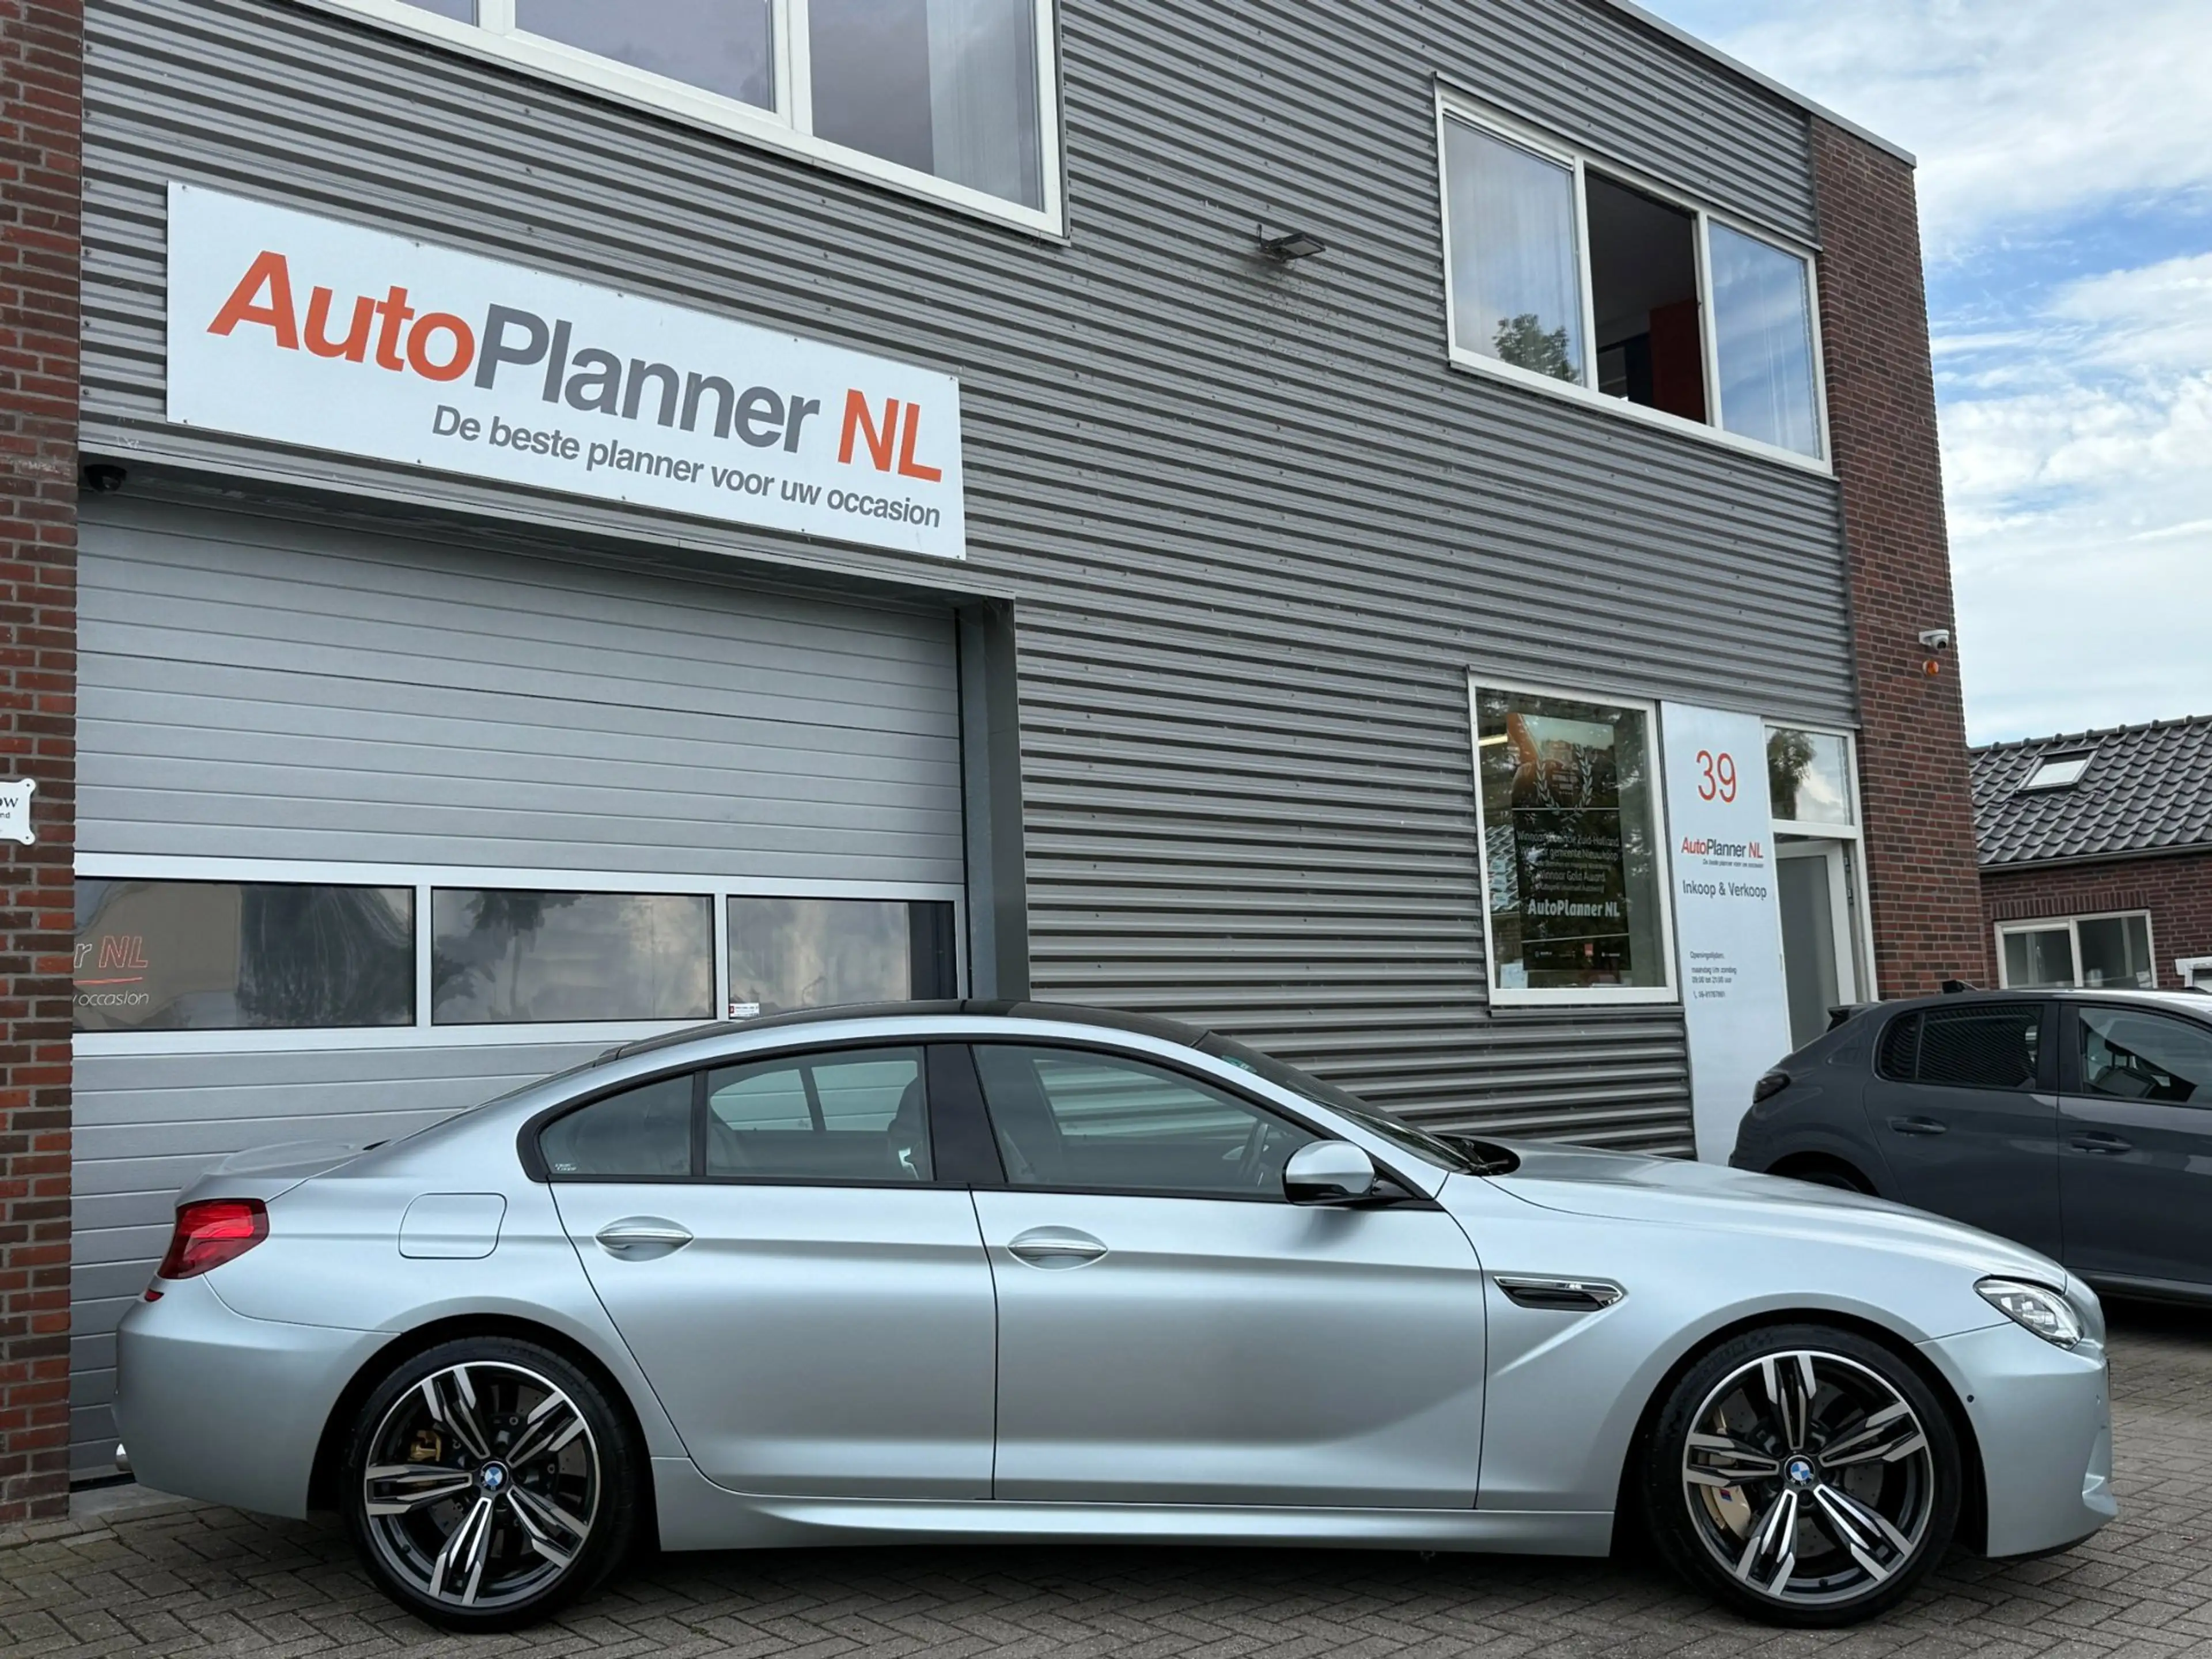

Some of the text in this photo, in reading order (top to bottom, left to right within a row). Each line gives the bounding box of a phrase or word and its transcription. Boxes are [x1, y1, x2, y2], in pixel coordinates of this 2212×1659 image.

[207, 251, 942, 483] AutoPlanner NL
[432, 404, 941, 528] De beste planner voor uw occasion
[1696, 749, 1736, 803] 39
[1681, 837, 1764, 858] AutoPlanner NL
[1683, 880, 1767, 901] Inkoop & Verkoop
[1528, 899, 1620, 917] AutoPlanner NL
[99, 935, 149, 968] NL
[78, 990, 149, 1006] occasion
